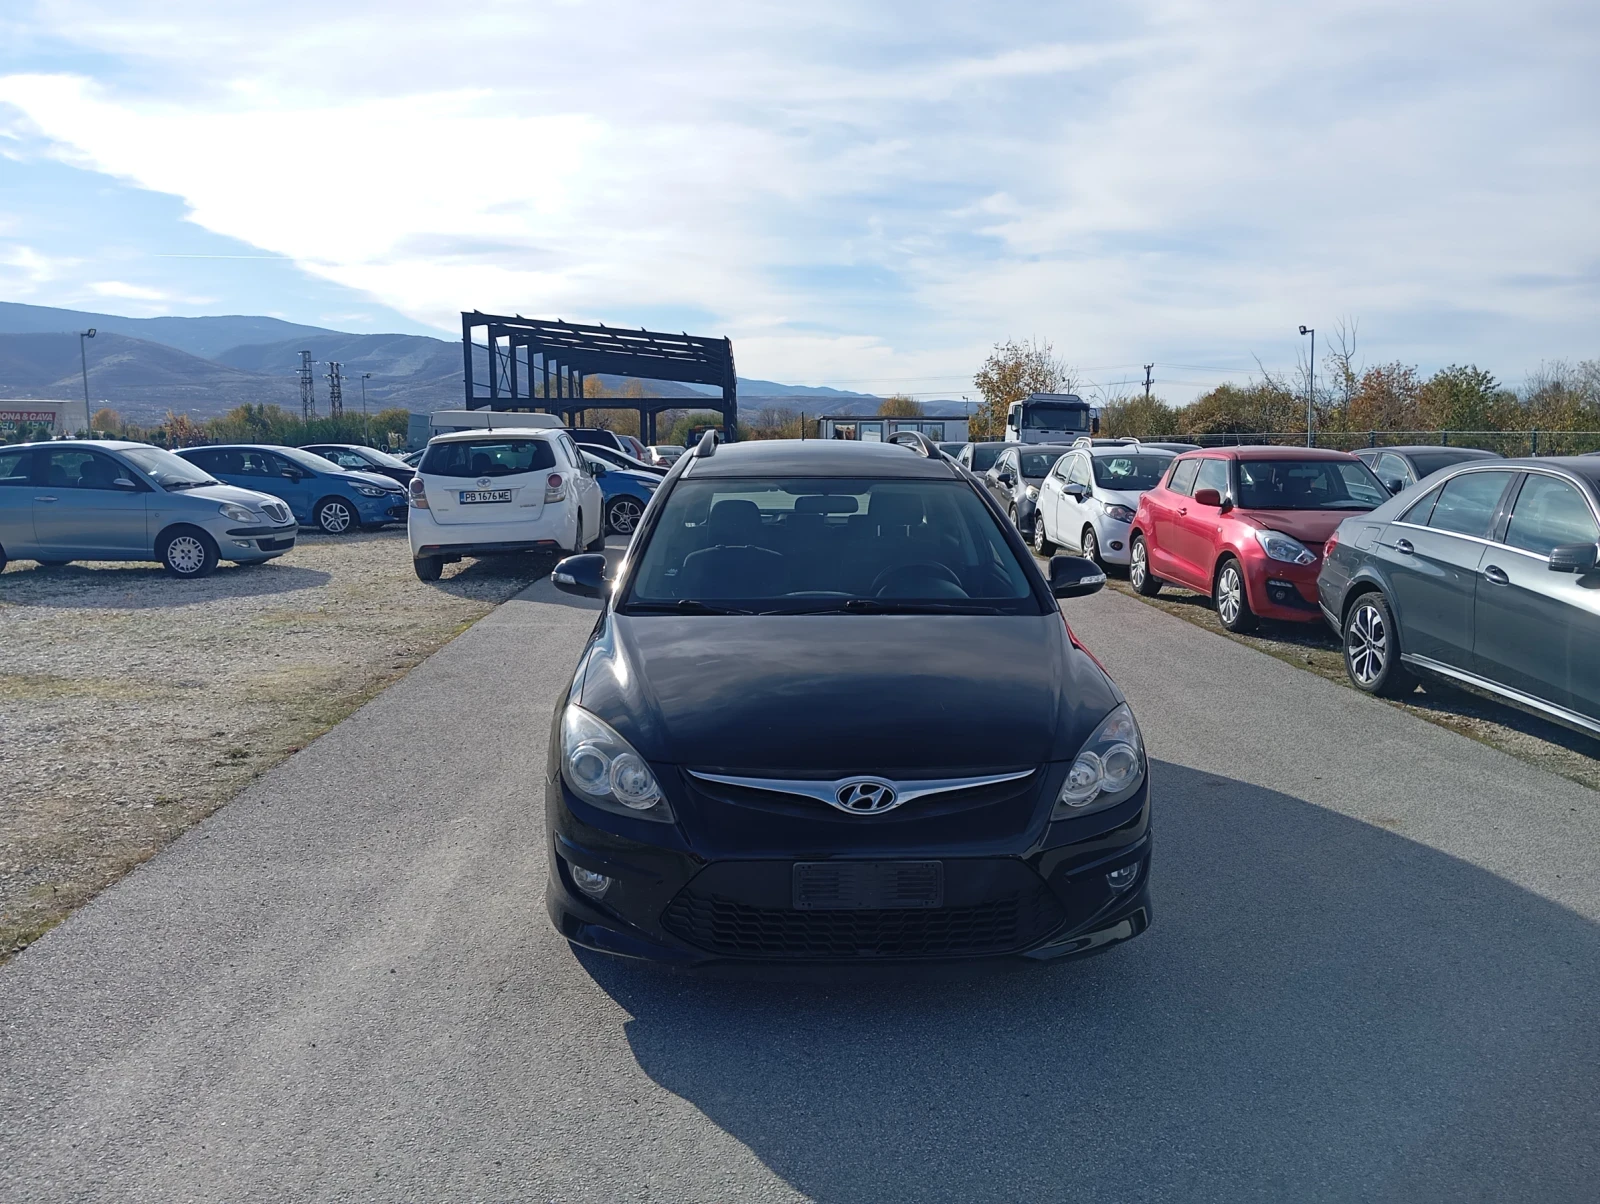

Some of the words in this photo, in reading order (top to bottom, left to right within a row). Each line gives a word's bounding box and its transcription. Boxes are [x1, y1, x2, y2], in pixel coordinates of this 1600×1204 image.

[0, 412, 20, 420] ONA
[22, 412, 28, 420] &
[29, 413, 53, 421] GAVA
[465, 493, 476, 501] PB
[478, 492, 497, 501] 1676
[498, 491, 509, 500] ME
